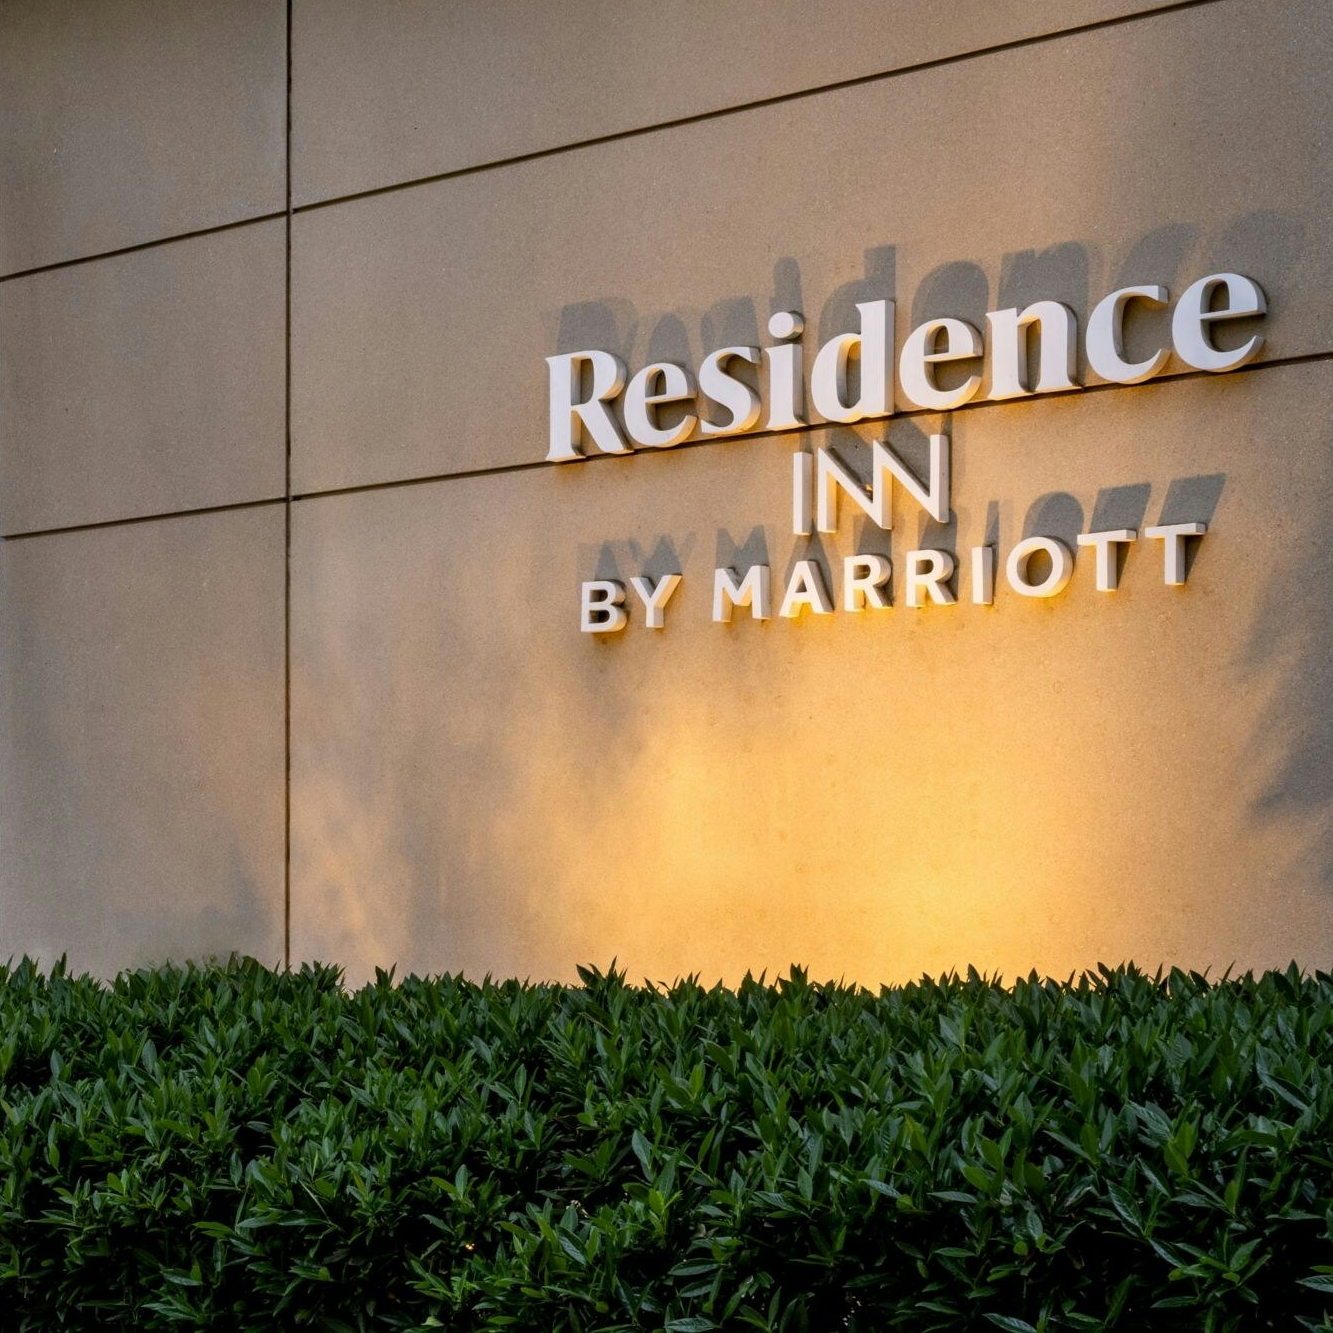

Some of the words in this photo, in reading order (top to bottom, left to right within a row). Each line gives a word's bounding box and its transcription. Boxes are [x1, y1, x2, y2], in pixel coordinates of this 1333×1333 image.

[545, 271, 1269, 463] Residence
[792, 433, 951, 536] INN
[580, 573, 683, 633] BY
[711, 522, 1207, 623] MARRIOTT
